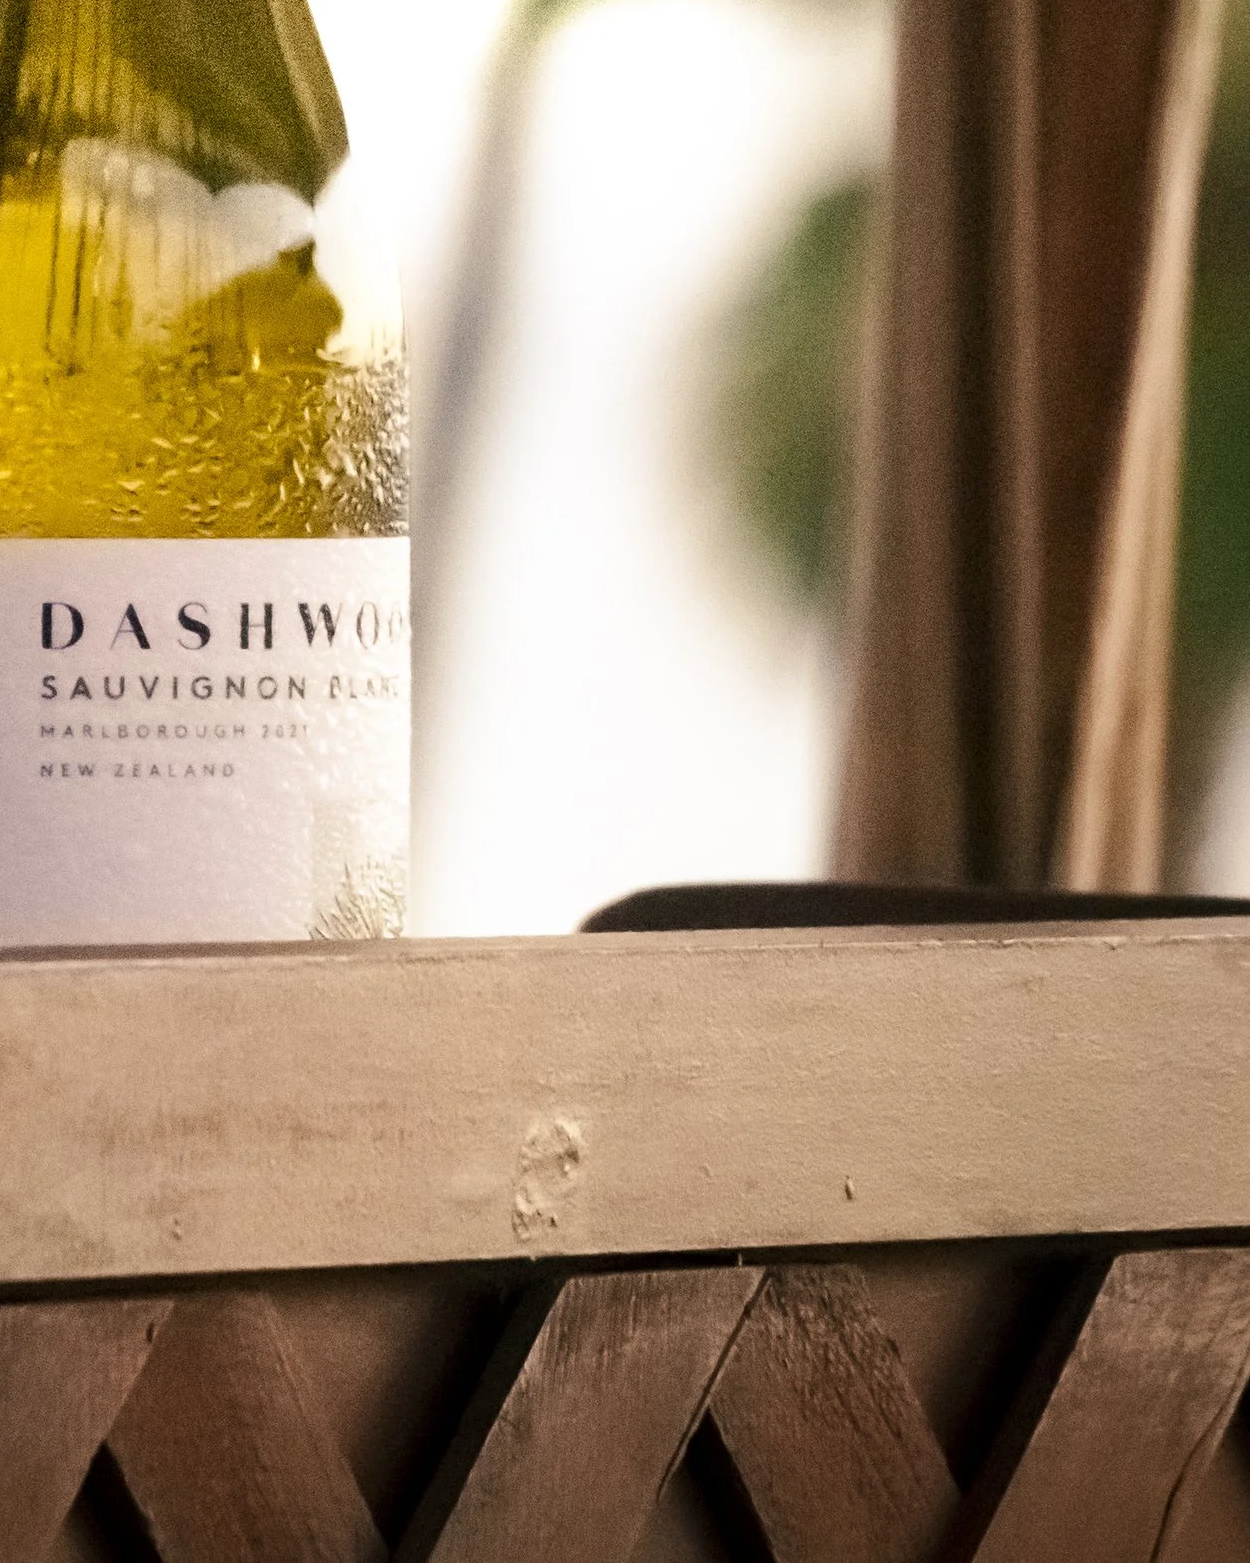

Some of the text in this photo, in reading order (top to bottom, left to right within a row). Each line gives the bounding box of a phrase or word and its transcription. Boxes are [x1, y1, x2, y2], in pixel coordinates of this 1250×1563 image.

[40, 674, 307, 701] SAUVIGNON
[40, 724, 247, 740] MARLBOROUGH
[40, 762, 236, 779] NEW ZEALAND
